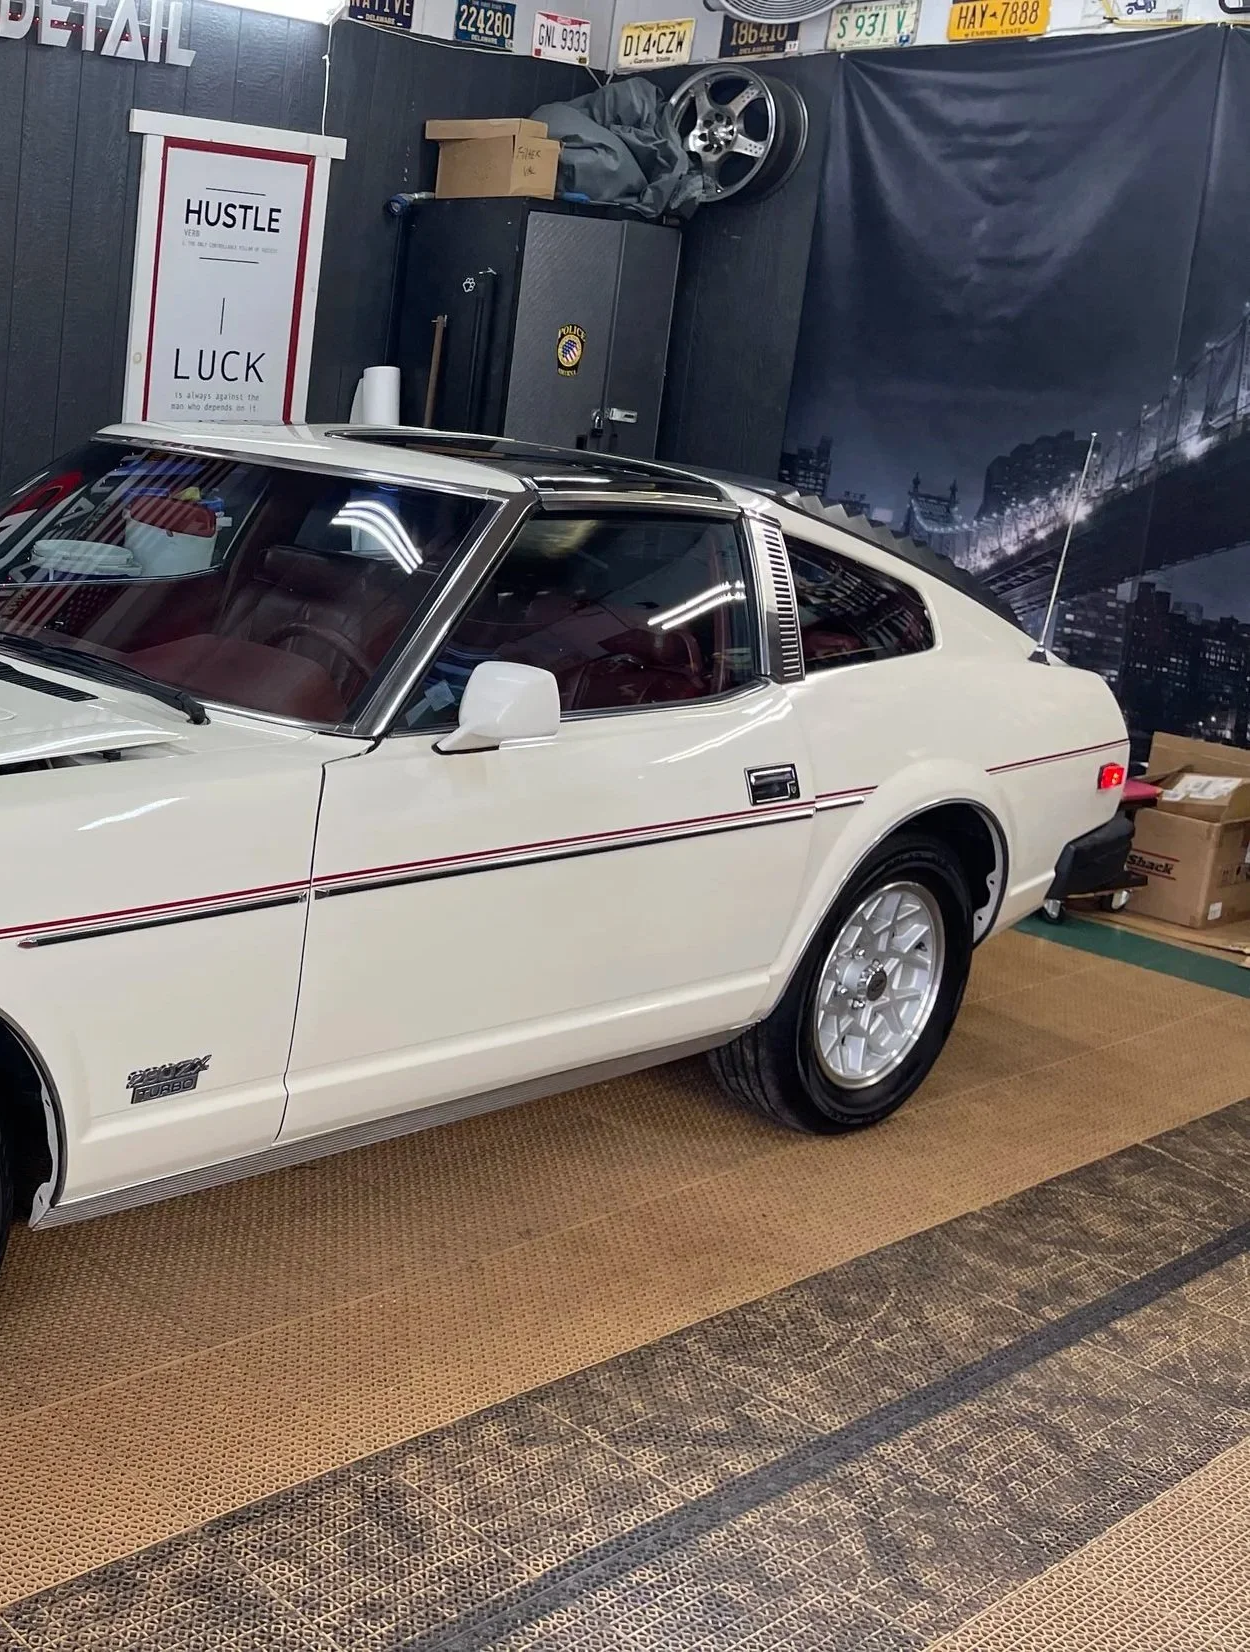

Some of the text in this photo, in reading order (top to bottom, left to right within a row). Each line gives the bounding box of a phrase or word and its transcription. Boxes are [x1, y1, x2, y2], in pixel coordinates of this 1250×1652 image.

[365, 13, 396, 25] DELAWARE
[459, 4, 512, 38] 224280
[837, 10, 907, 39] S 931 V
[956, 0, 1040, 30] HAY 7888
[538, 24, 588, 53] GNL 9333
[730, 22, 788, 46] 186410
[185, 198, 282, 233] HUSTLE
[184, 229, 200, 237] VERB
[558, 325, 586, 341] POLICE
[174, 348, 265, 382] LUCK
[187, 392, 211, 401] always
[215, 393, 243, 402] against
[247, 393, 259, 401] the
[204, 404, 232, 413] depends
[1126, 854, 1174, 876] Shack
[138, 1079, 194, 1101] TURBO
